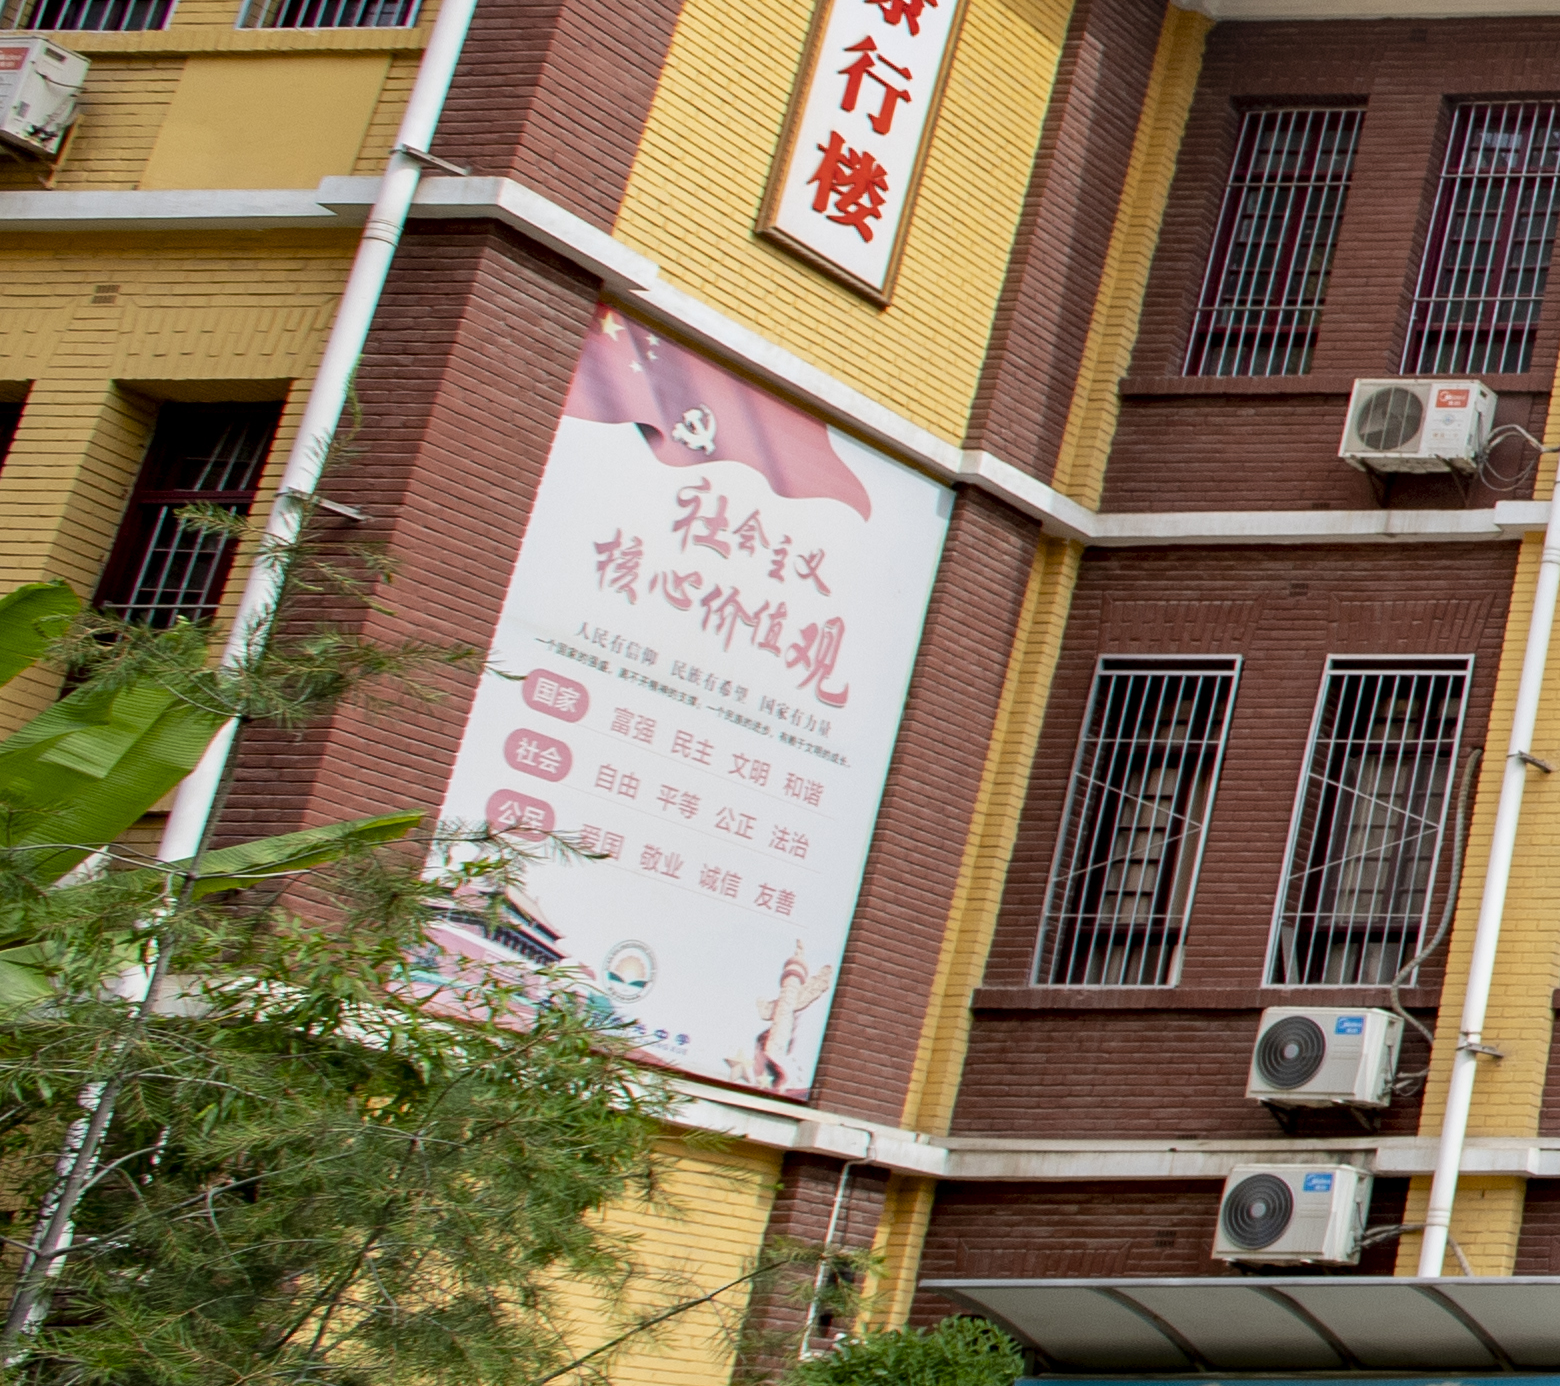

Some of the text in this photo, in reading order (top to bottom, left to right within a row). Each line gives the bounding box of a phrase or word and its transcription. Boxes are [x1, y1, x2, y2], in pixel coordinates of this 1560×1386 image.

[672, 476, 831, 597] 社会主义
[593, 528, 850, 709] 核心价值观
[515, 737, 810, 860] 社会 自由 平等 公正 法治
[532, 677, 825, 808] 国家 富强 民主 文明 和谐
[497, 799, 797, 916] 公民 爱国 敬业 诚信 友善
